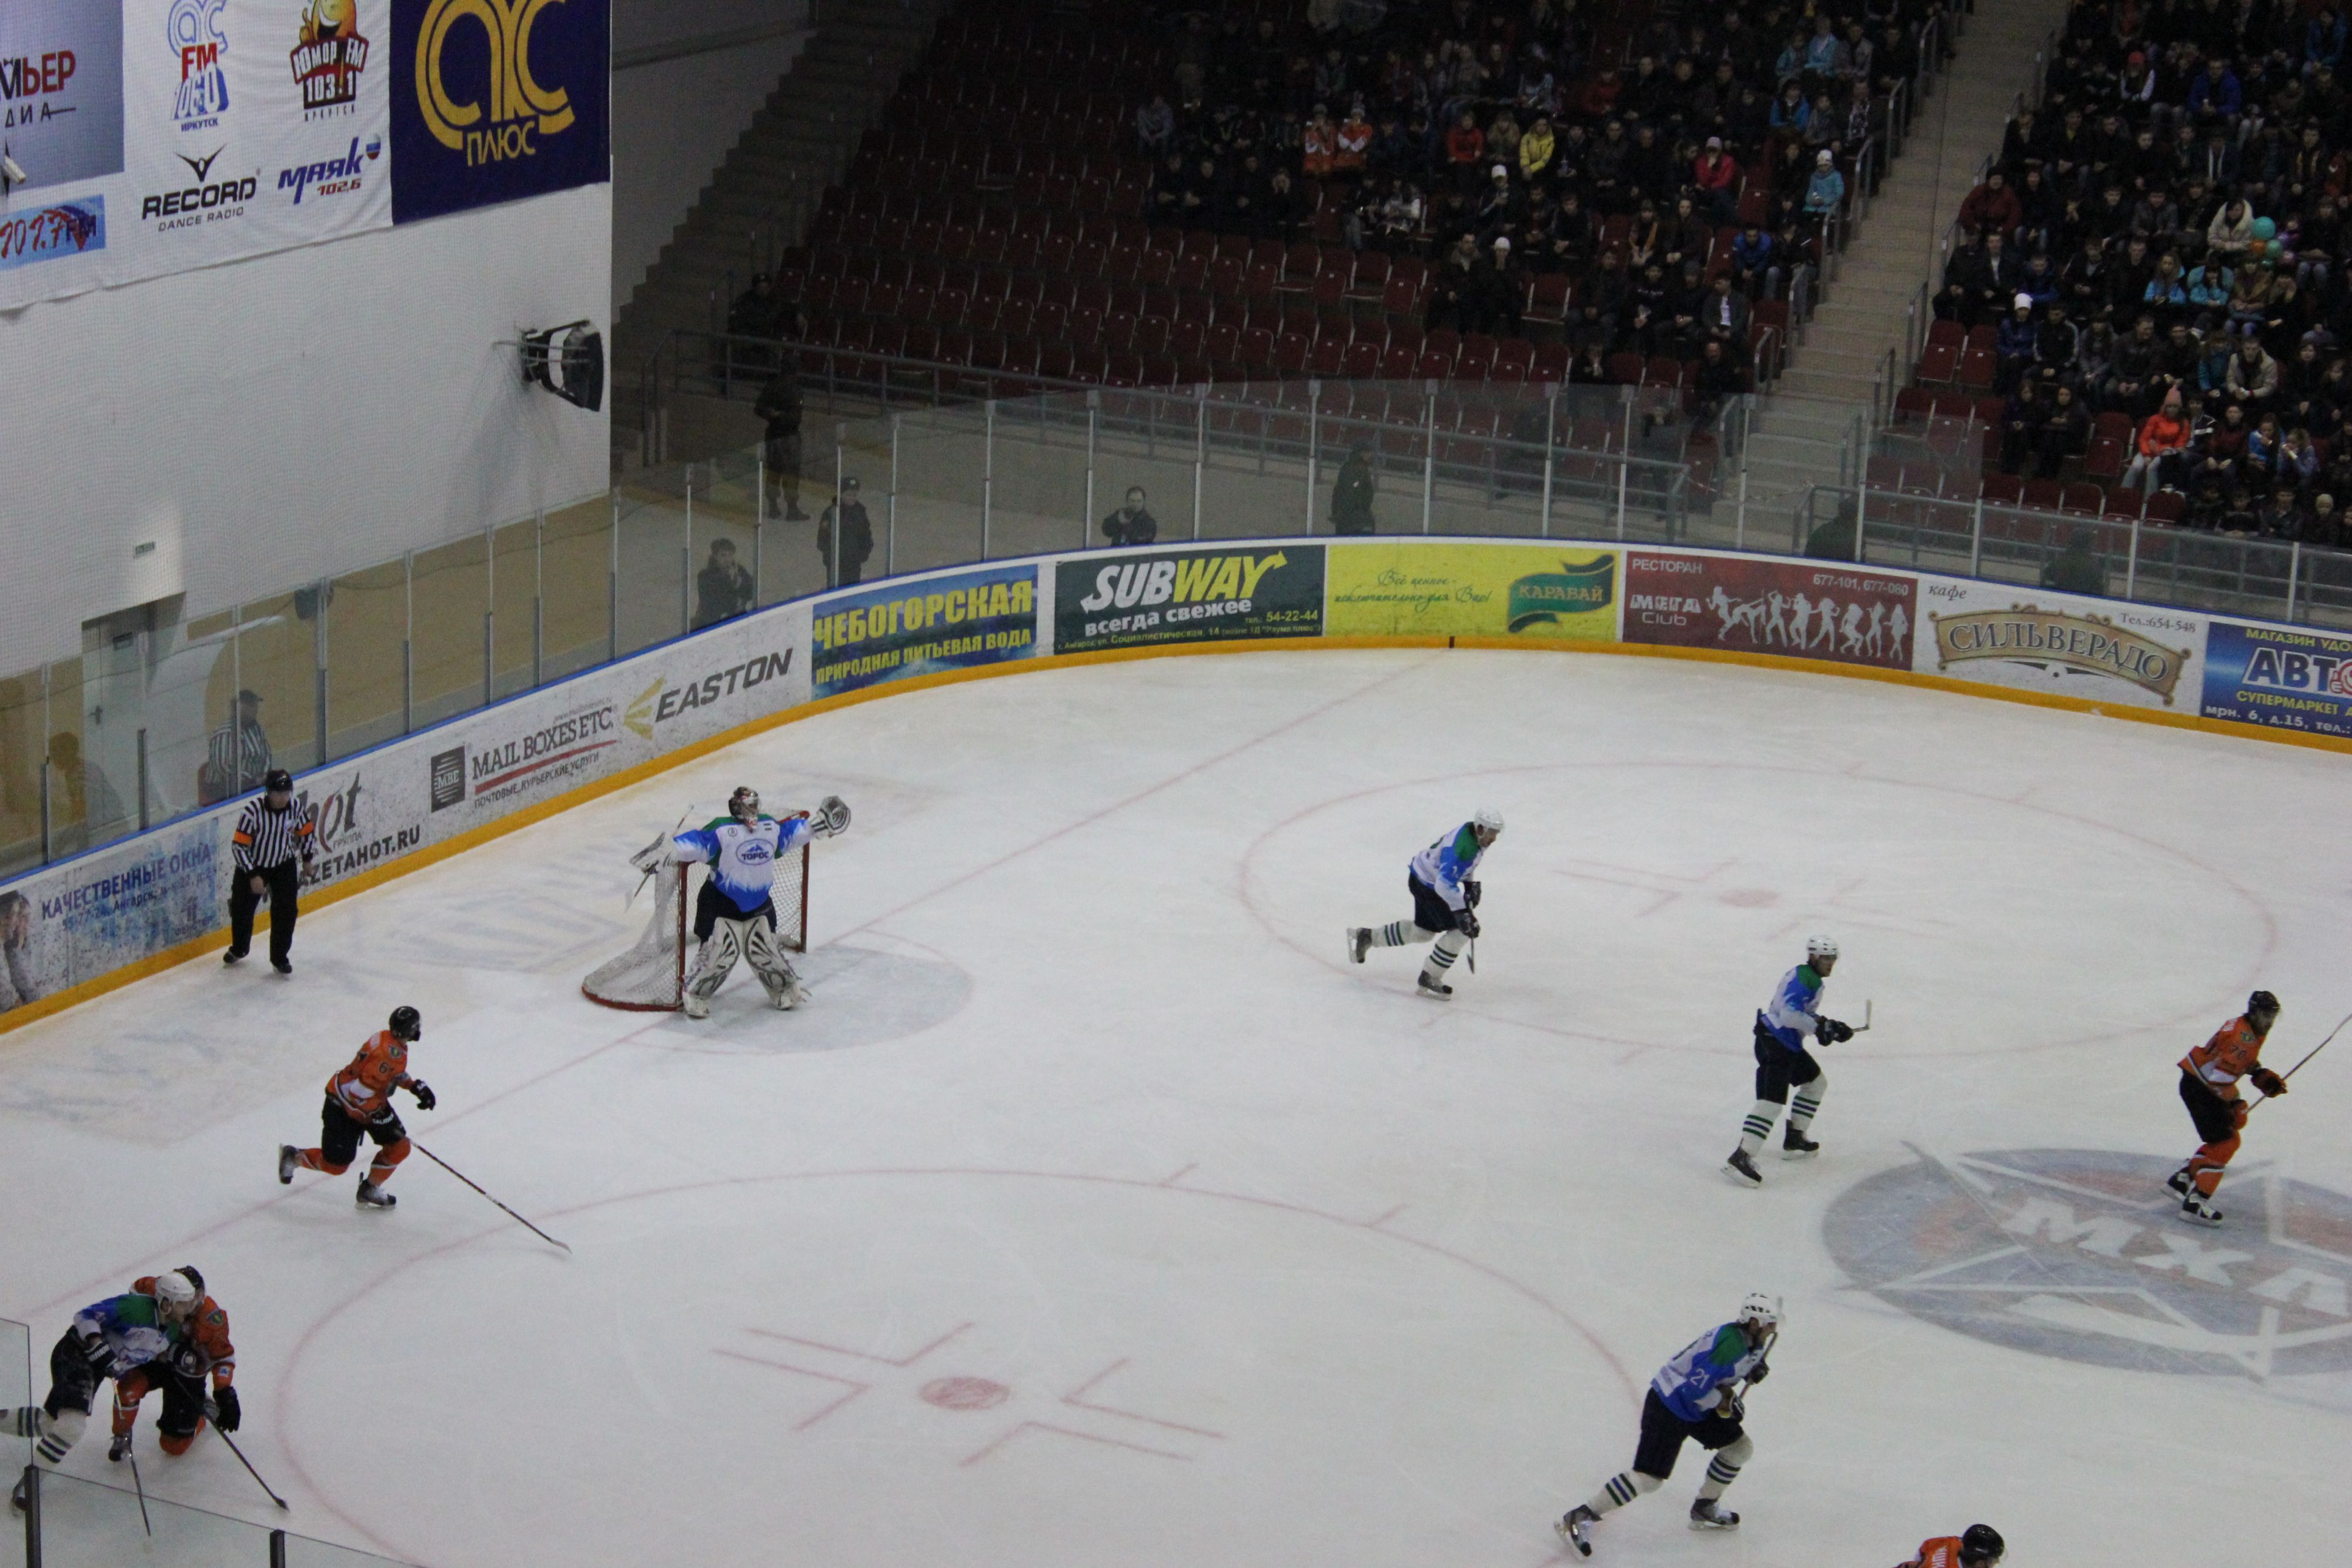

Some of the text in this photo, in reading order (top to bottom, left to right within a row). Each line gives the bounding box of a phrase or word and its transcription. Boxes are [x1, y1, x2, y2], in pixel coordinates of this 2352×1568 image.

[306, 71, 353, 103] 103.1
[181, 117, 218, 132] ИРКУТСК
[466, 120, 536, 167] ПЛЮС
[142, 177, 257, 220] RECORD
[158, 206, 243, 232] DANCE RADIO
[1080, 550, 1288, 613] SUBWAY
[1632, 559, 1703, 574] РЕСТОРАН
[1518, 585, 1603, 602] КАРАВАЙ
[1928, 585, 1967, 601] кафе
[813, 580, 1033, 650] ЧЕБОГОРСКАЯ
[1085, 599, 1252, 637] всегда свежее
[1266, 610, 1318, 623] 54-22-44
[1948, 621, 2170, 681] СИЛЬВЕРАДО
[2246, 627, 2316, 647] МАГАЗИН
[816, 628, 1031, 685] ПРИРОДНАЯ ПИТЬЕВАЯ ВОДА
[655, 647, 793, 723] EASTON
[2236, 690, 2340, 715] СУПЕРМАРКЕТ
[472, 741, 520, 780] MAIL
[523, 717, 576, 760] BOXES
[741, 851, 770, 861] ТОРОС
[42, 842, 212, 921] КАЧЕСТВЕННЫЕ ОКНА
